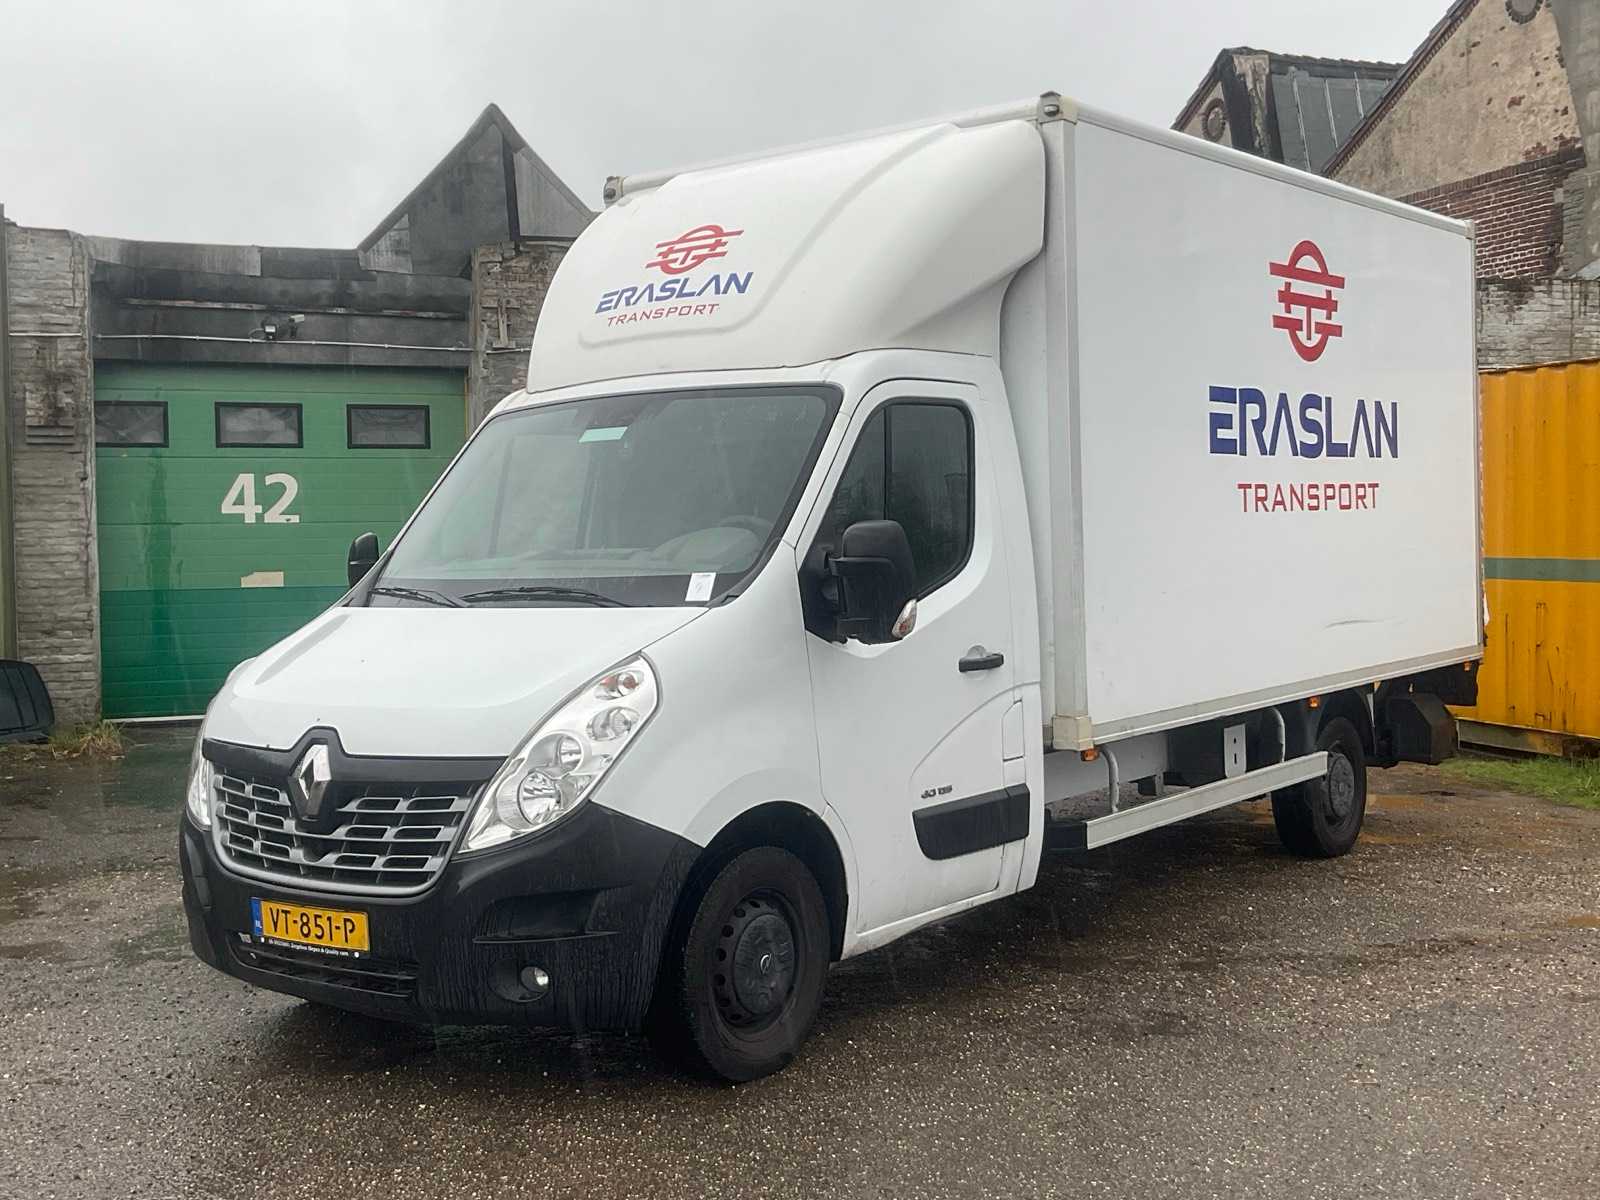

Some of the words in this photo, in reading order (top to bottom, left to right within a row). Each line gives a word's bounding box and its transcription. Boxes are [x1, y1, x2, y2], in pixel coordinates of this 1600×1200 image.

[595, 271, 754, 314] ERASLAN
[607, 303, 720, 327] TRANSPORT
[1209, 385, 1399, 459] ERASLAN
[221, 473, 300, 523] 42
[1237, 482, 1380, 513] TRANSPORT
[269, 906, 356, 944] VT-851-P
